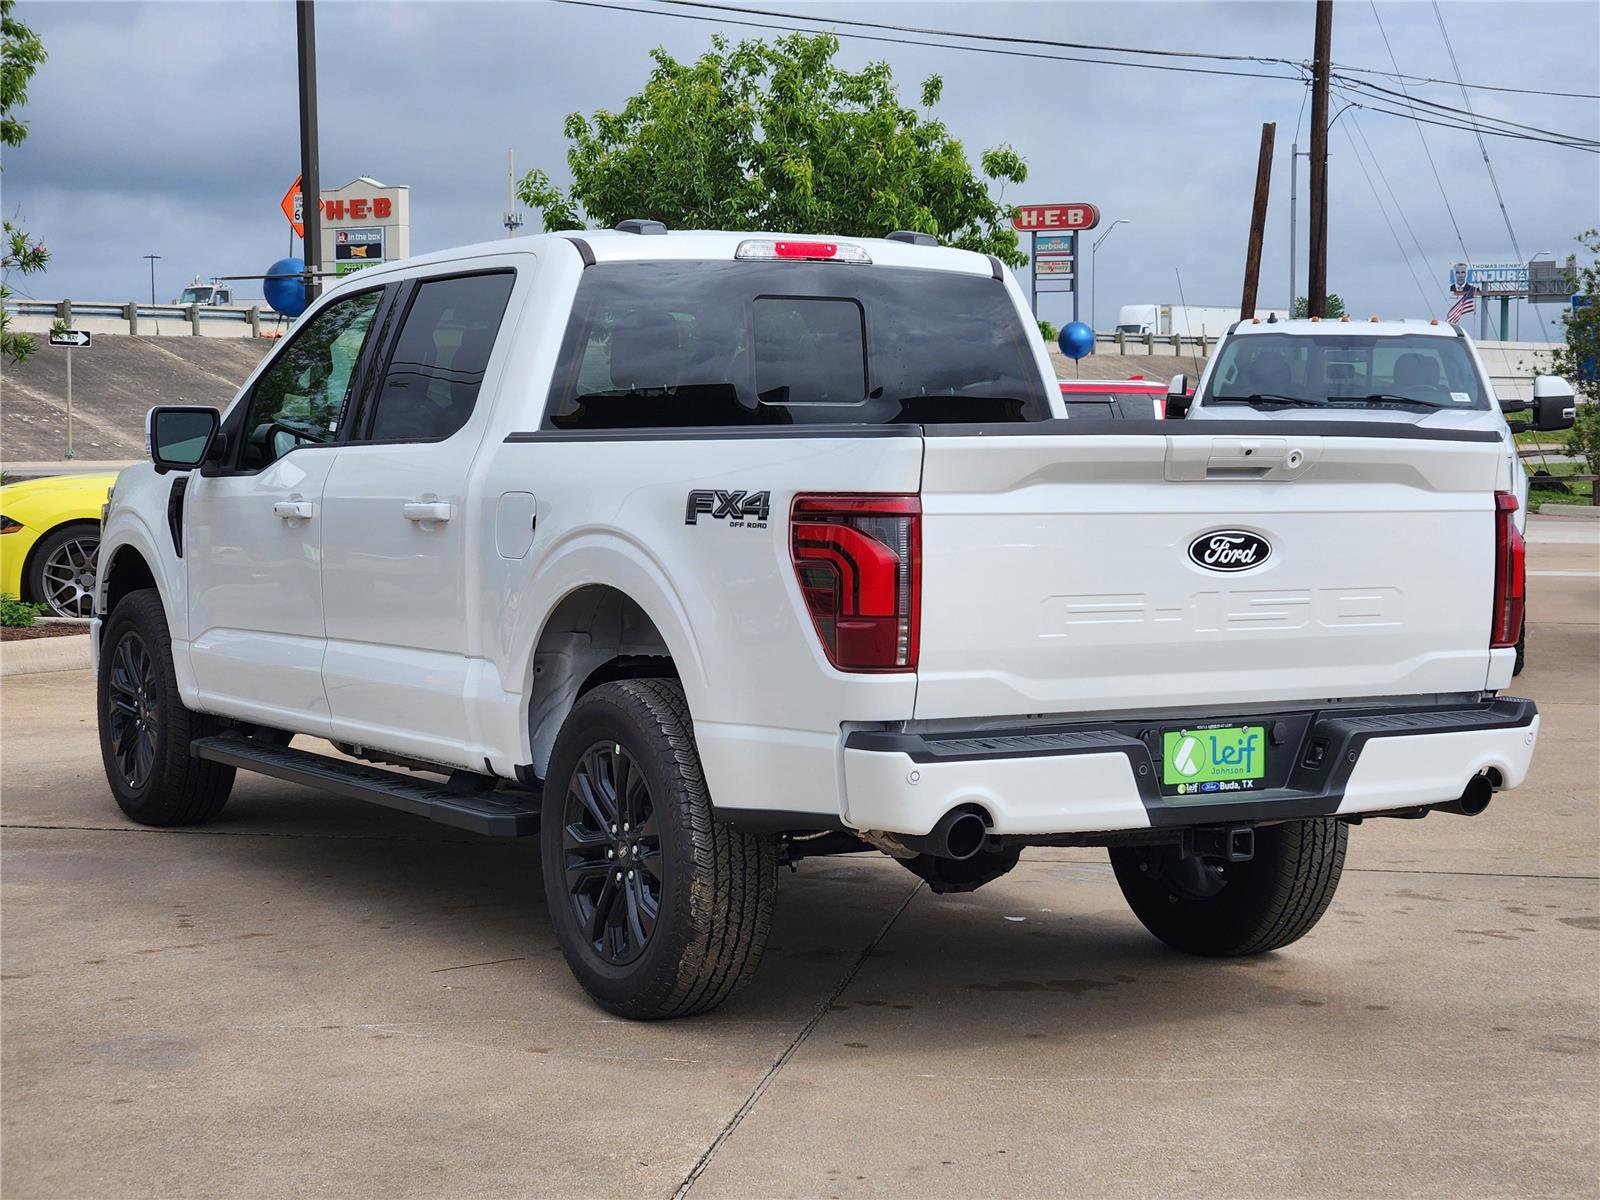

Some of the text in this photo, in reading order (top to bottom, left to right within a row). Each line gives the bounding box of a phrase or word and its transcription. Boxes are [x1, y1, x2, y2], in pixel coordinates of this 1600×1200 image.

[356, 231, 367, 241] the
[368, 231, 381, 240] box
[1472, 270, 1529, 281] INJURE
[685, 489, 771, 525] FX4
[1204, 536, 1258, 563] Ford
[1211, 767, 1244, 775] Johnson
[1220, 781, 1241, 790] Buda,
[1242, 779, 1254, 788] TX
